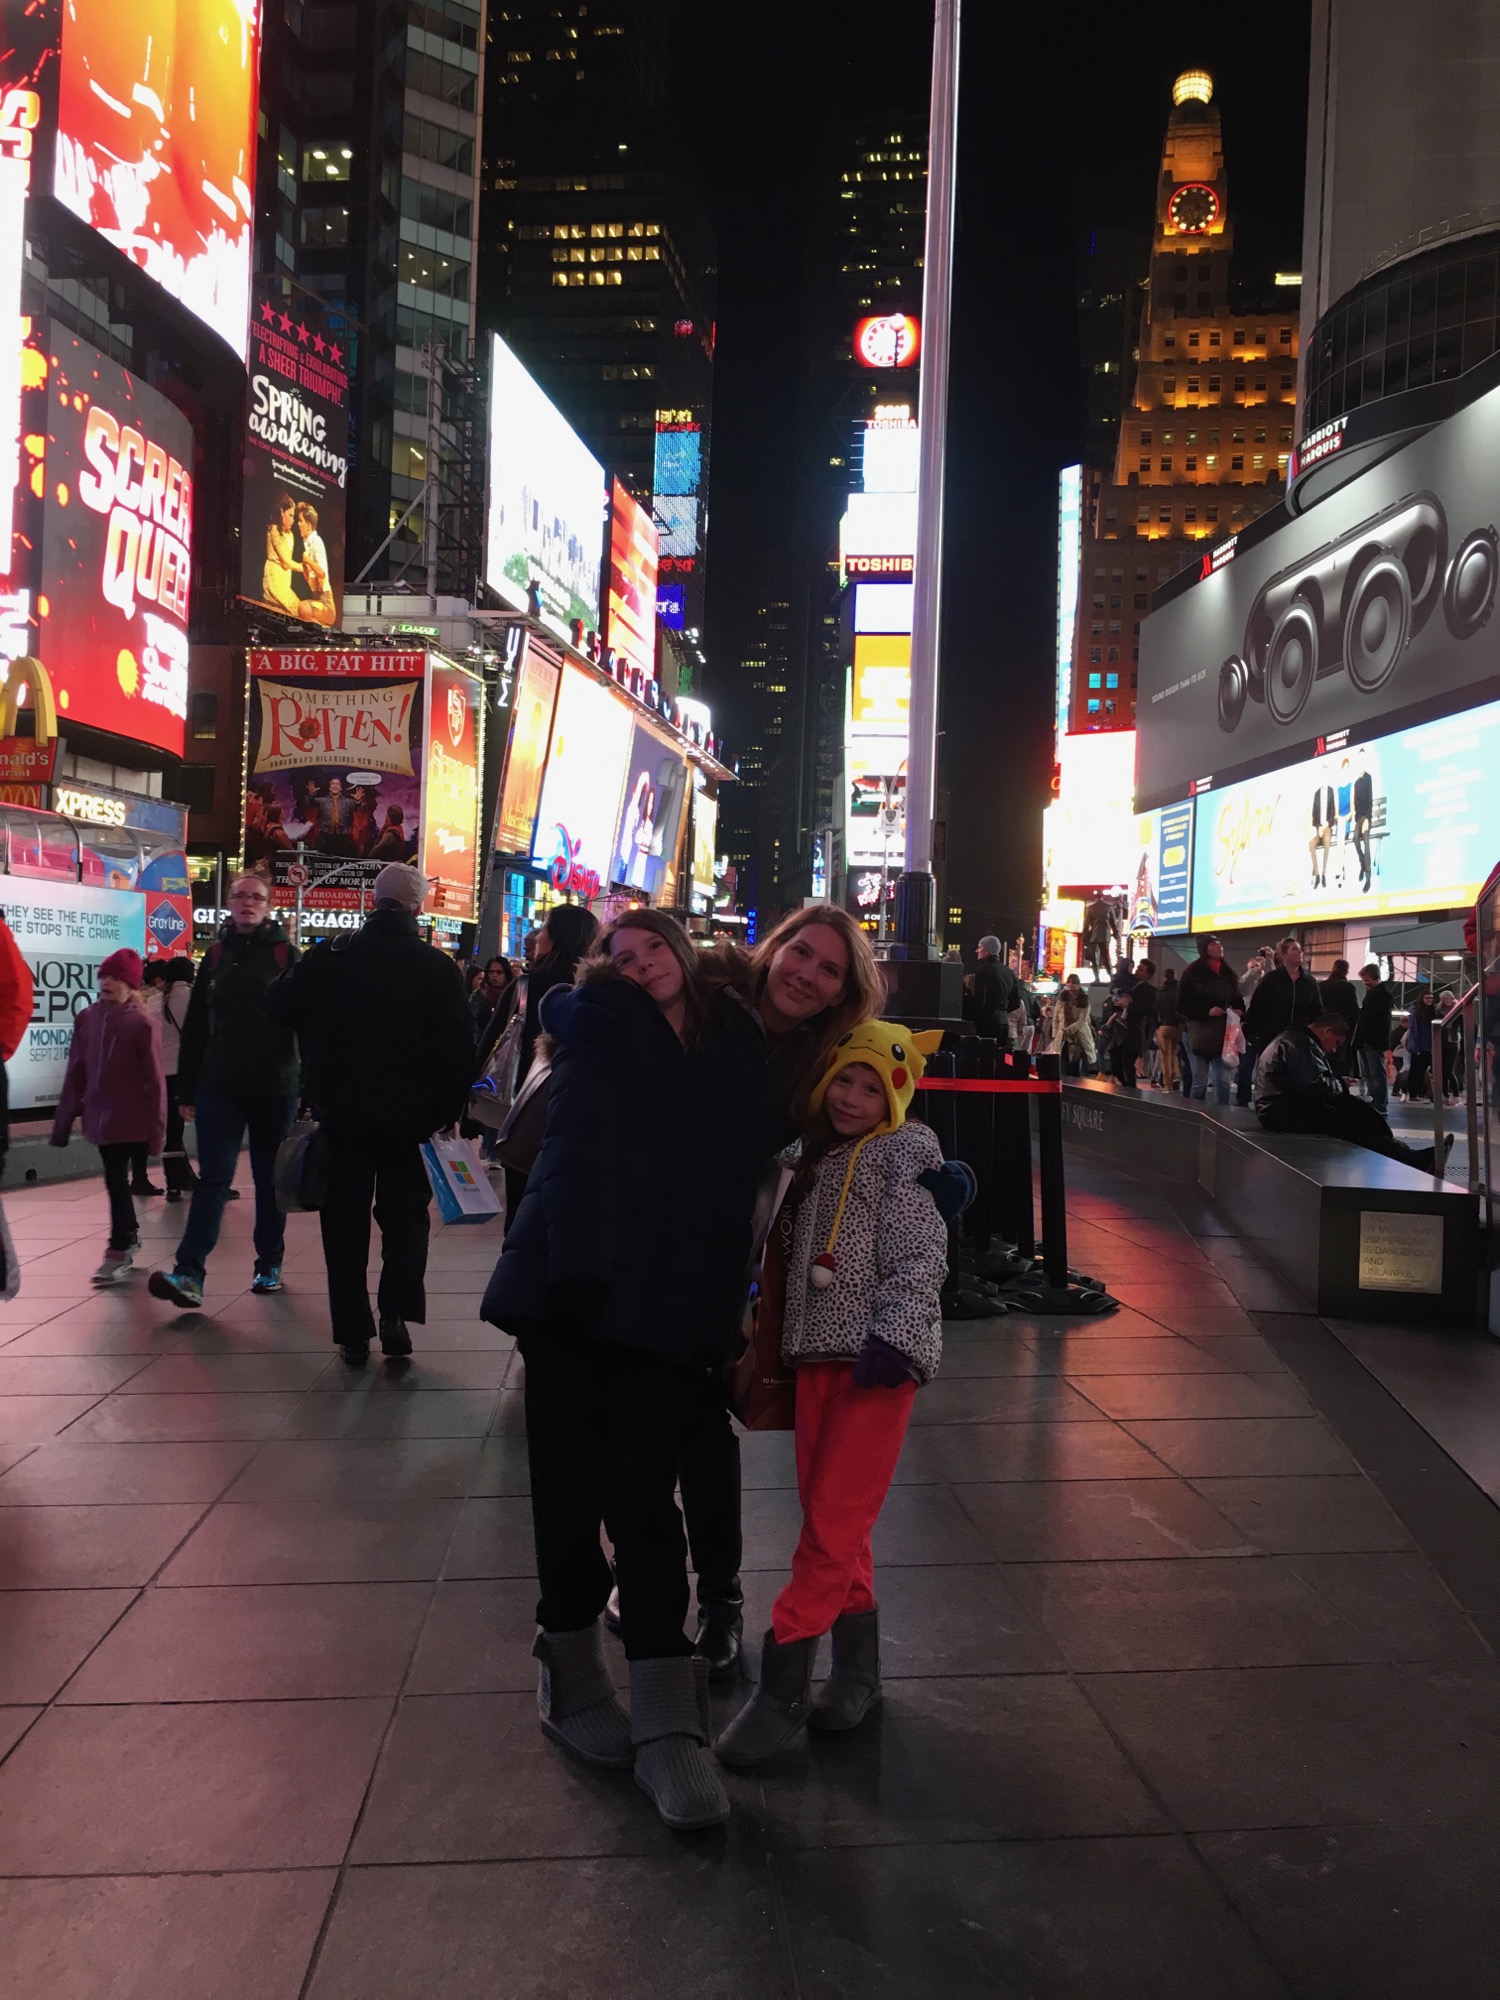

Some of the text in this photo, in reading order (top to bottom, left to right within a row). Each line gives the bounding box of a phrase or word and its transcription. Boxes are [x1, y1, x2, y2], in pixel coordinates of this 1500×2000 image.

[259, 343, 266, 365] A
[267, 347, 297, 381] SHEER
[252, 374, 327, 442] SPRING
[1301, 416, 1348, 453] MARRIOTT
[248, 413, 348, 488] awakening
[1300, 436, 1340, 468] MARQUIS
[325, 655, 364, 672] FAT
[281, 689, 394, 706] SOMETHING
[55, 788, 126, 826] XPRESS
[33, 907, 54, 921] SEE
[57, 909, 77, 923] THE
[26, 921, 62, 936] STOPS
[65, 925, 85, 938] THE
[1073, 1104, 1104, 1131] SQUARE
[1363, 1257, 1385, 1266] AND
[1374, 1246, 1436, 1257] DANGEROUS
[1363, 1268, 1415, 1278] UNLAWFUL
